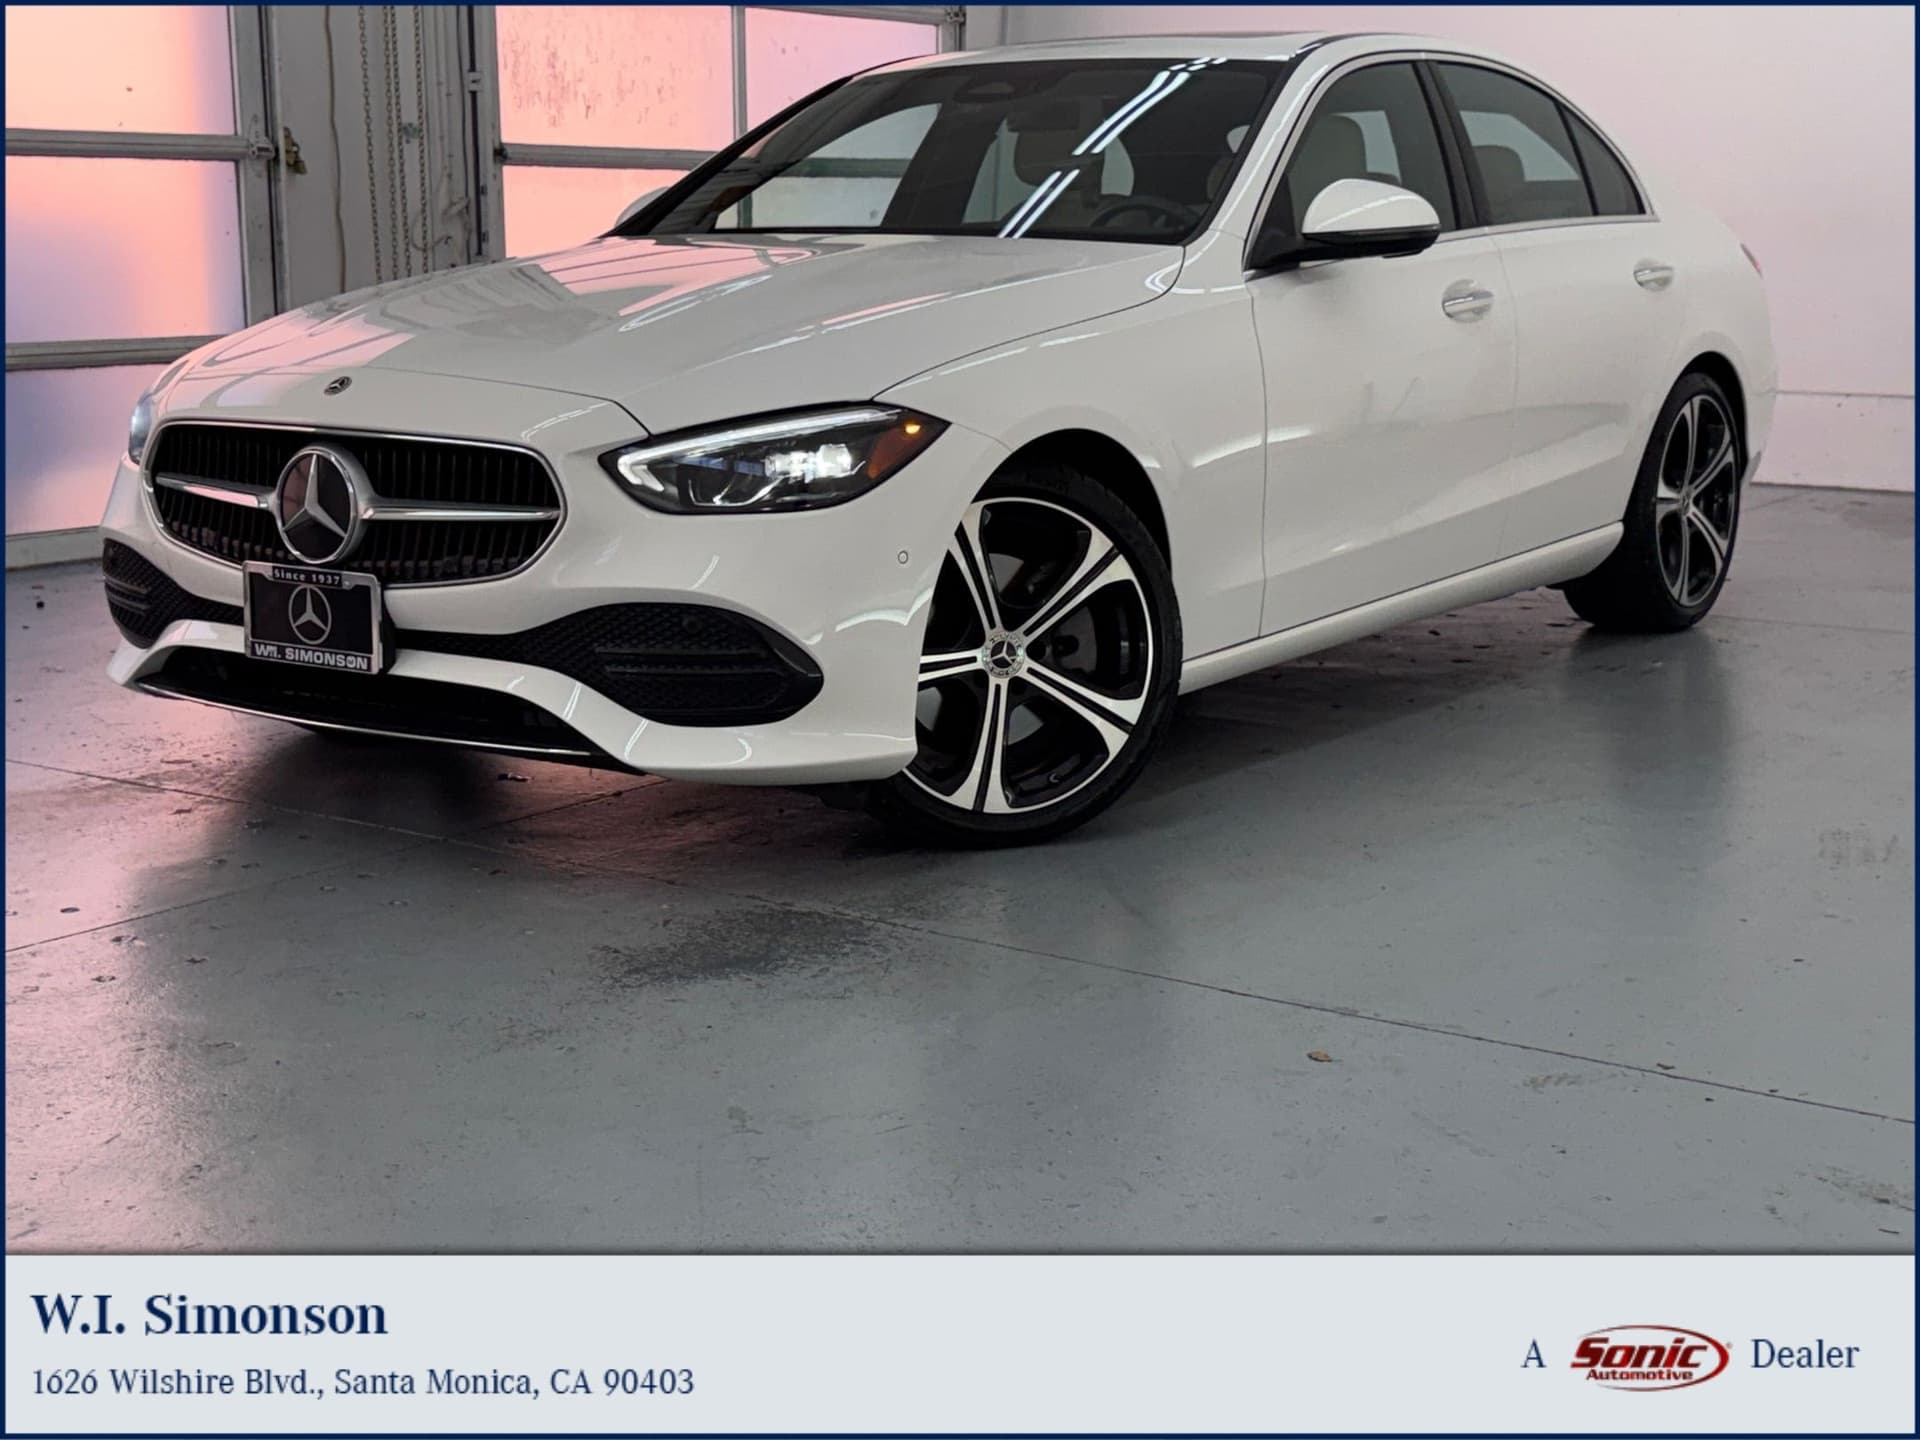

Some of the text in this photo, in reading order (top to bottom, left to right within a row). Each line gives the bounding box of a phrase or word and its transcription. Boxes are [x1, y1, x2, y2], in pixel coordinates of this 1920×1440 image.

[274, 568, 340, 585] Since 1937
[285, 647, 368, 671] SIMONSON
